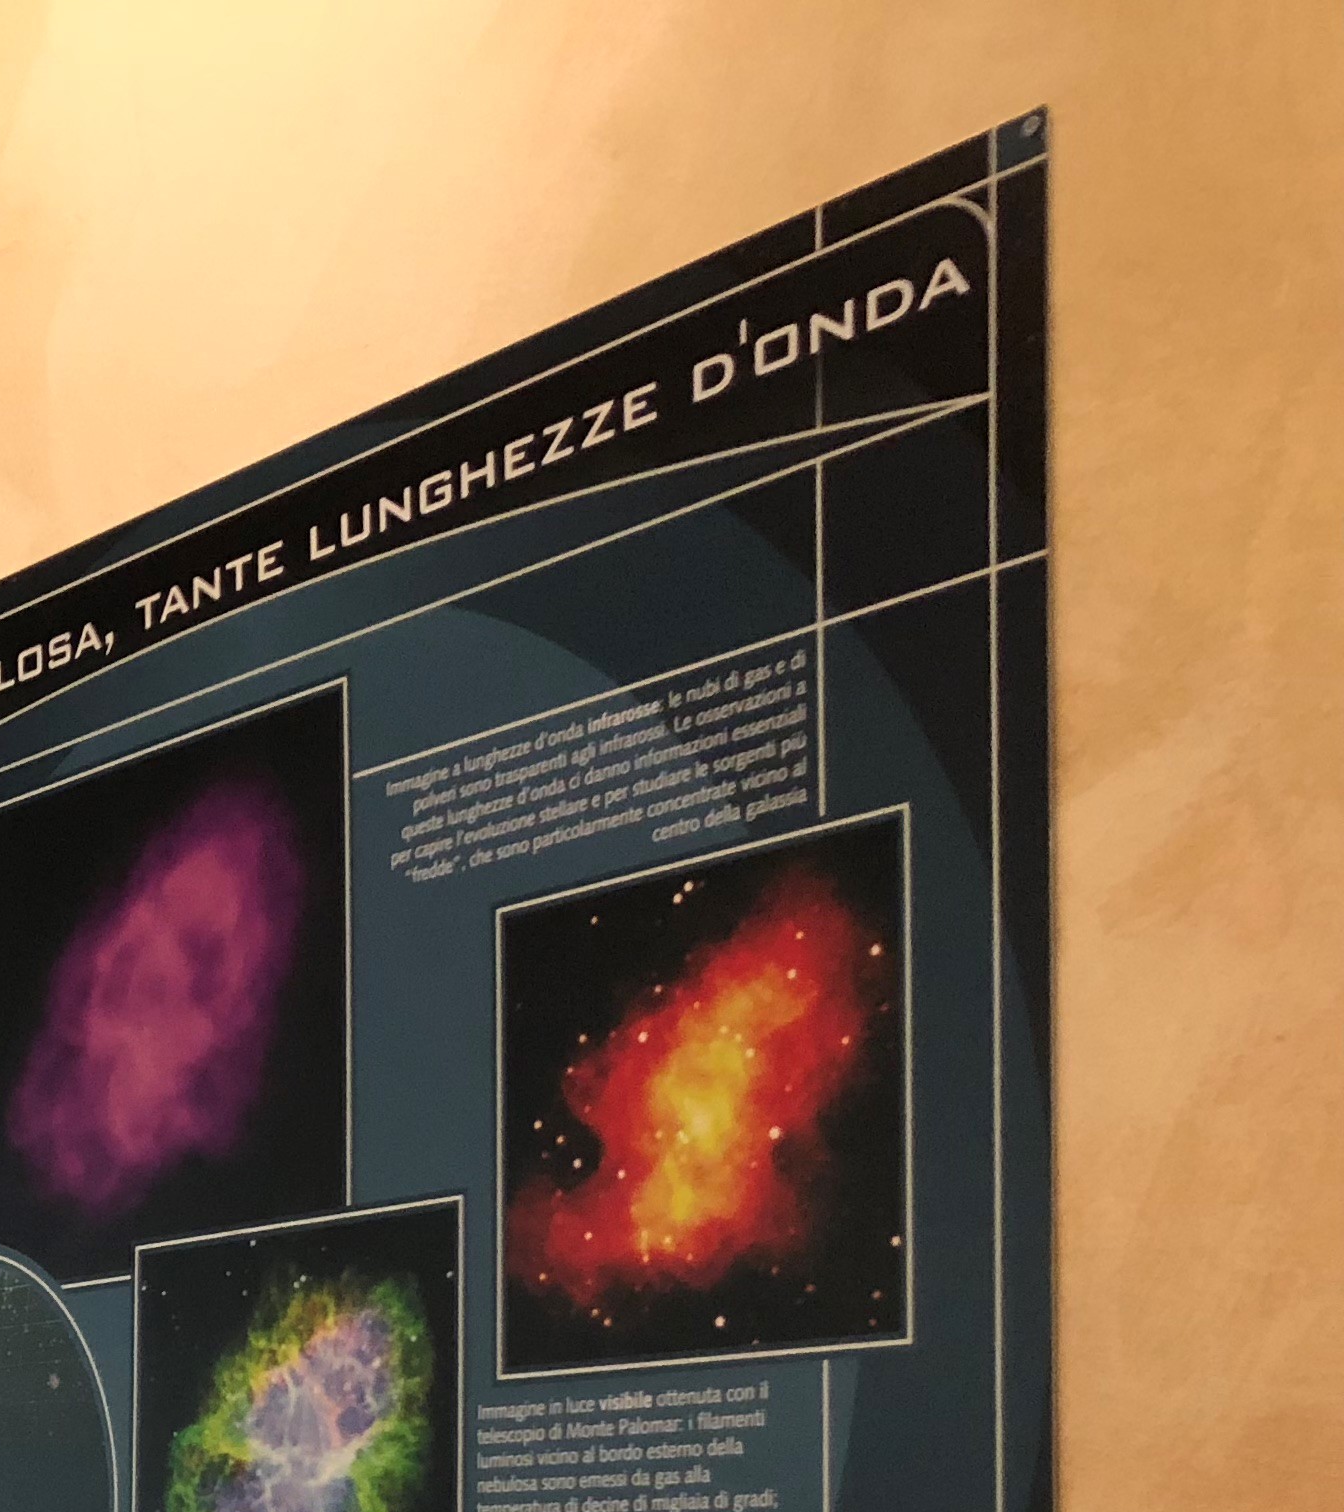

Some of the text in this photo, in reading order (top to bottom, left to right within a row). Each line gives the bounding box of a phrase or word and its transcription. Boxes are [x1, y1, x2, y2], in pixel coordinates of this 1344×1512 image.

[134, 539, 284, 630] TANTE
[309, 381, 657, 561] LUNGHEZZE
[692, 257, 969, 402] D'ONDA
